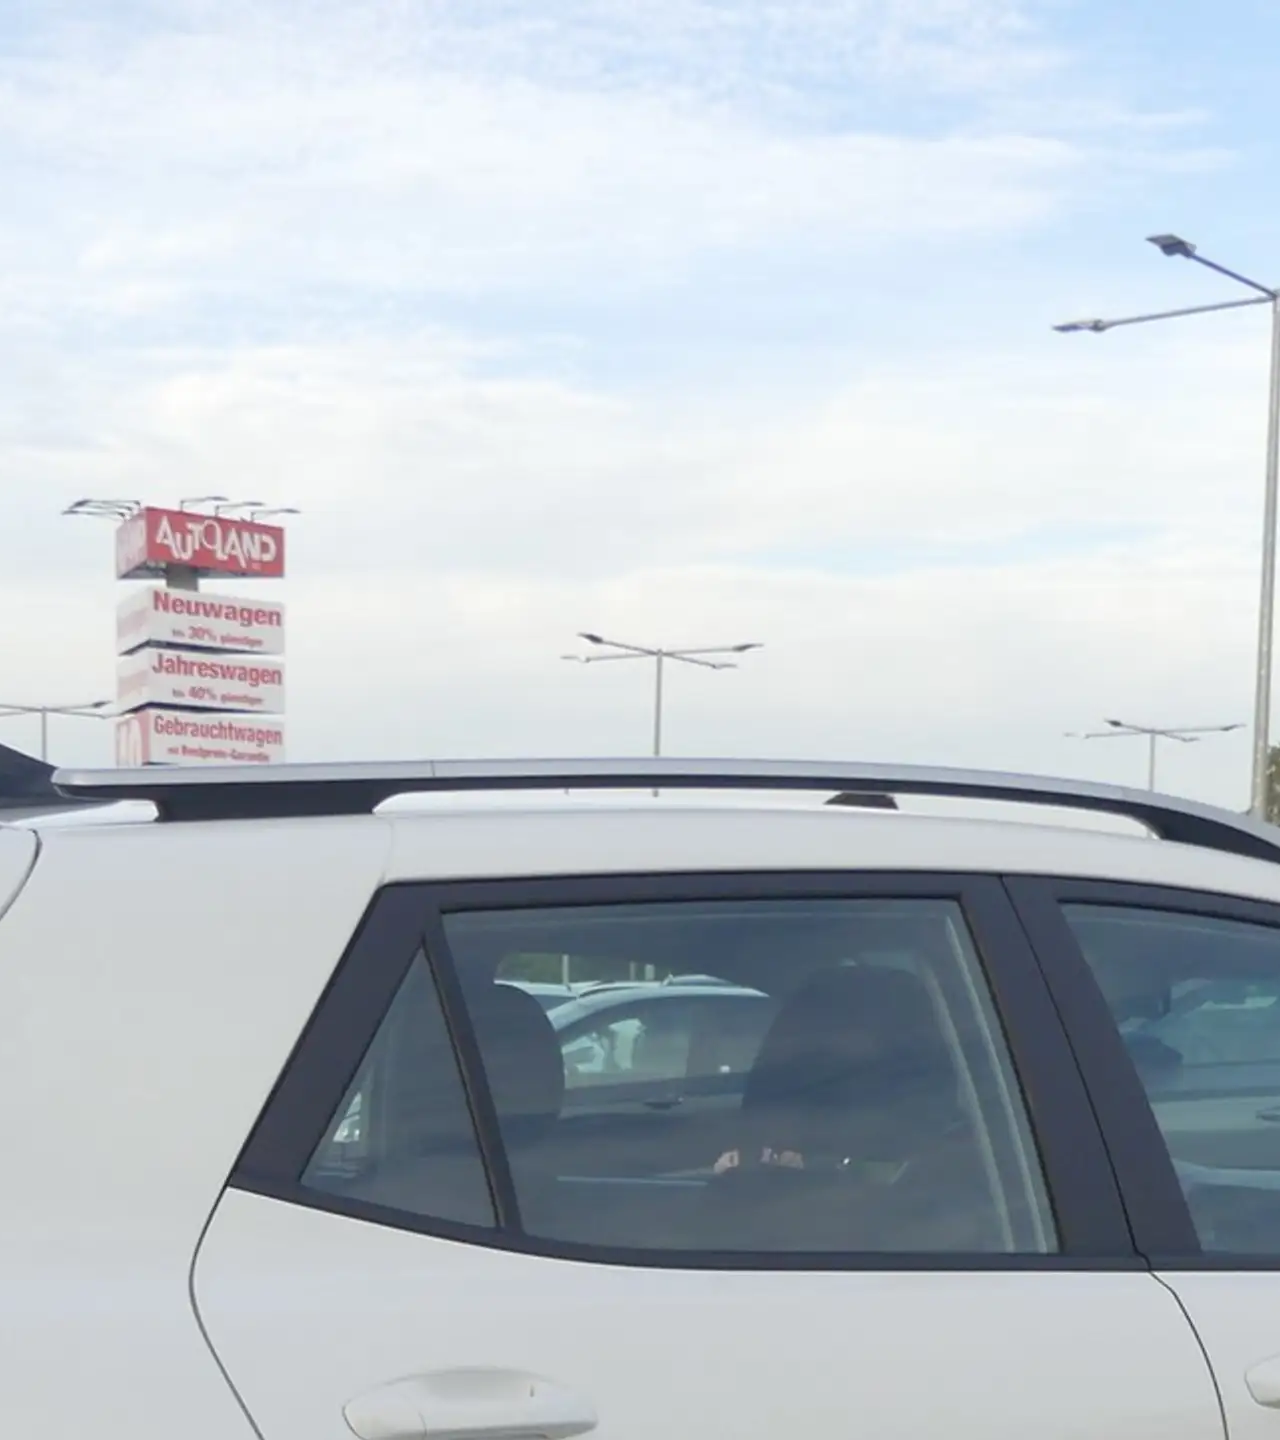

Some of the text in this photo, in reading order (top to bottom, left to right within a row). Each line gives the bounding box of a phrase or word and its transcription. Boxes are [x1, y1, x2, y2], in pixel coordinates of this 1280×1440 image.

[156, 515, 276, 568] AUTOLAND
[153, 590, 282, 627] Neuwagen
[152, 653, 282, 687] Jahreswagen
[153, 714, 282, 747] Gebrauchtwagen
